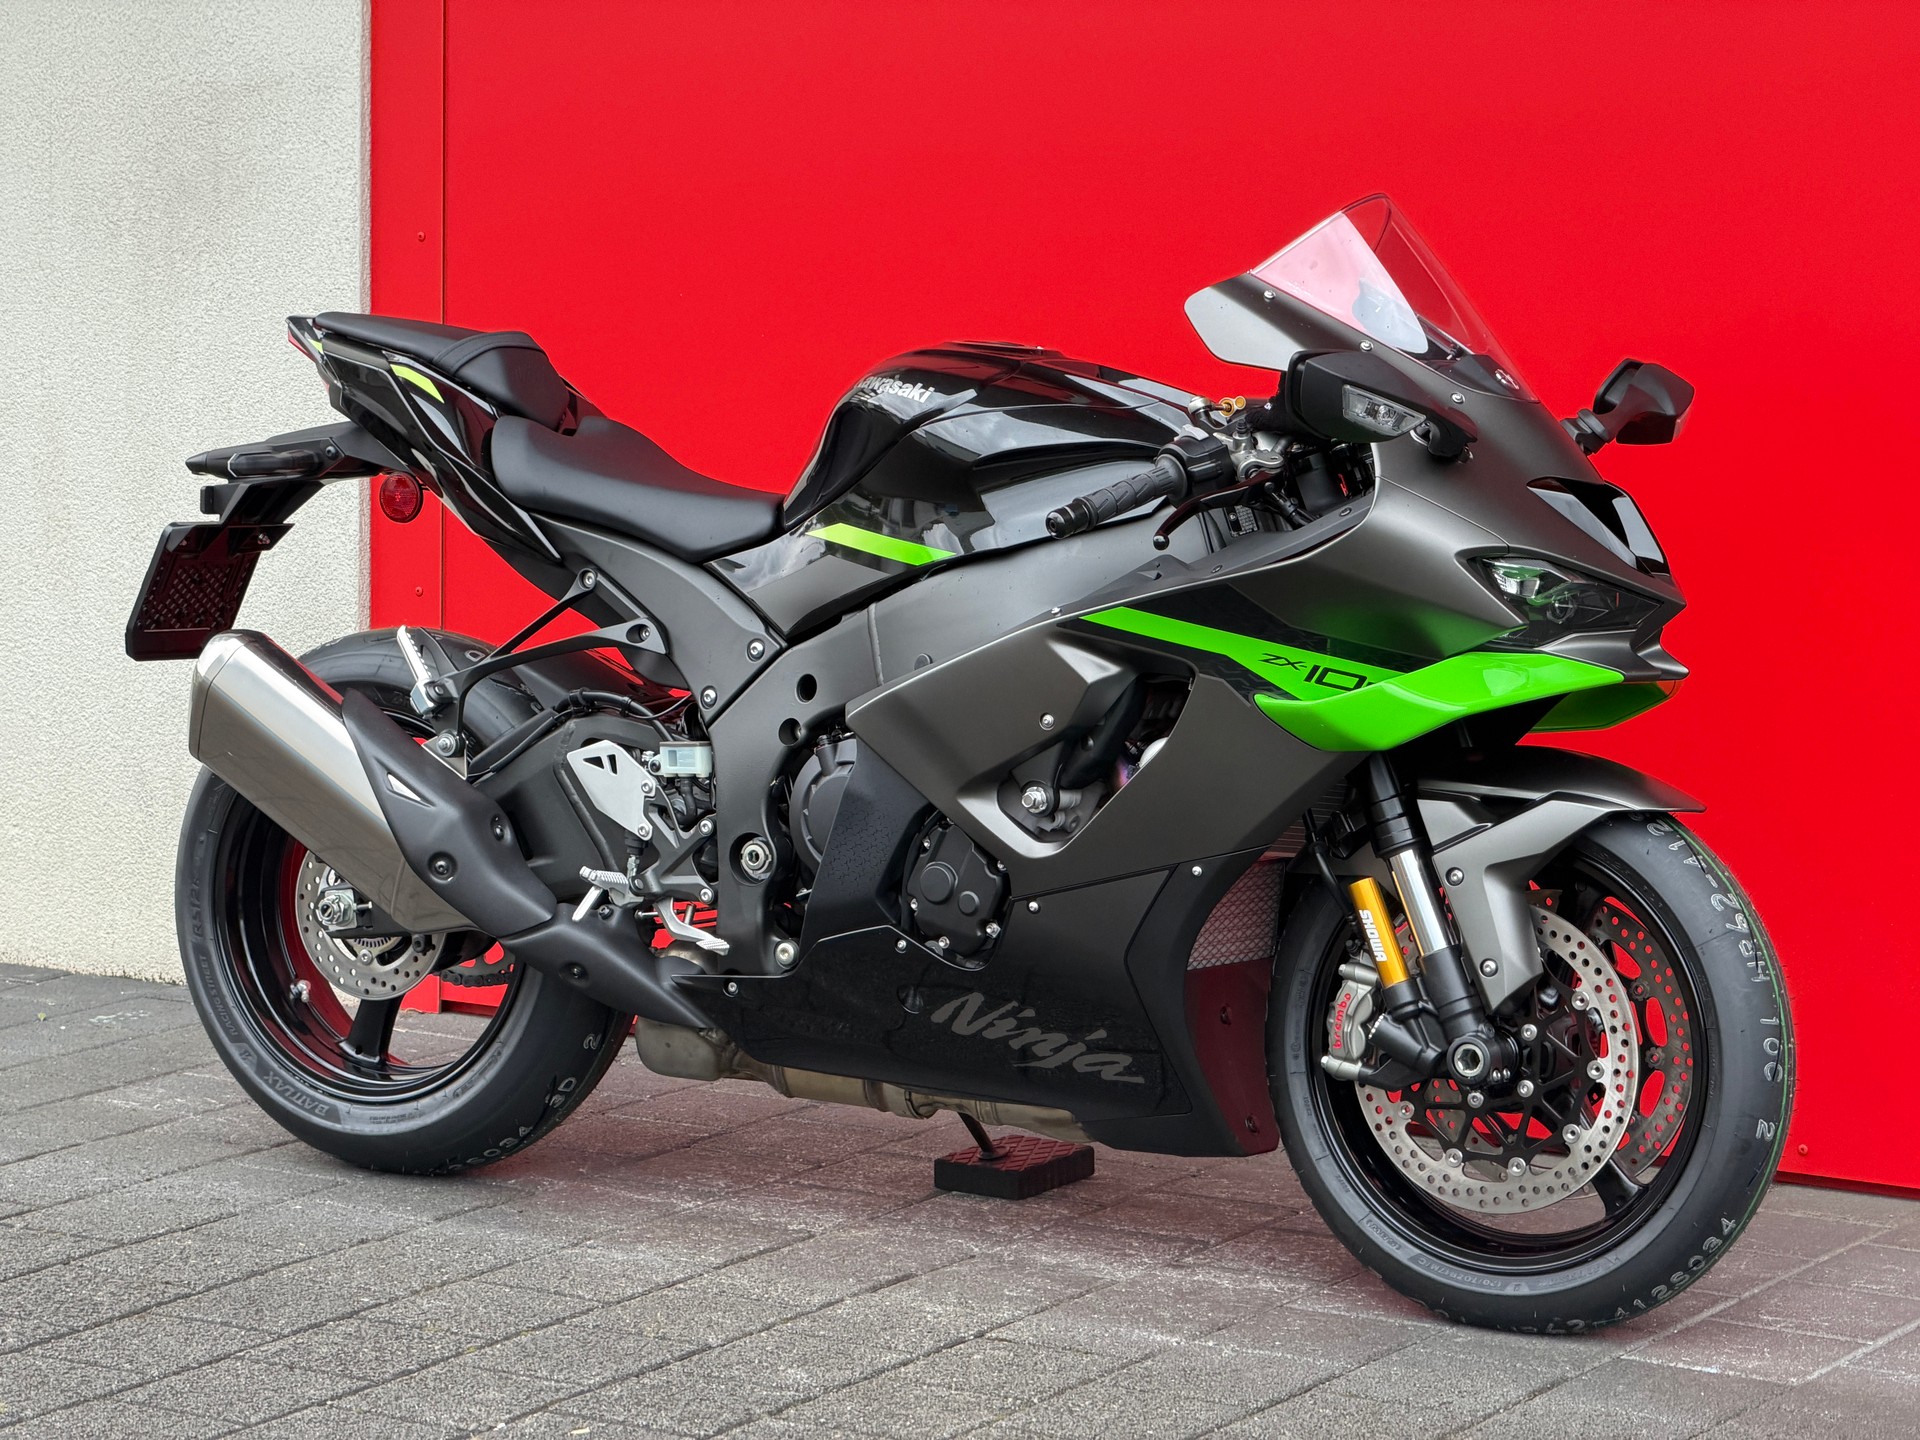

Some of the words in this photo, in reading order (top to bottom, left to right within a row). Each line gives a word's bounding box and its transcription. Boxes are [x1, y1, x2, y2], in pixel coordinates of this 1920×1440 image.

[1258, 653, 1376, 692] ZX-10
[1359, 909, 1387, 962] SHOWA
[930, 991, 1145, 1084] Ninja
[1332, 992, 1352, 1050] brembo
[263, 1071, 330, 1117] BATTLAX
